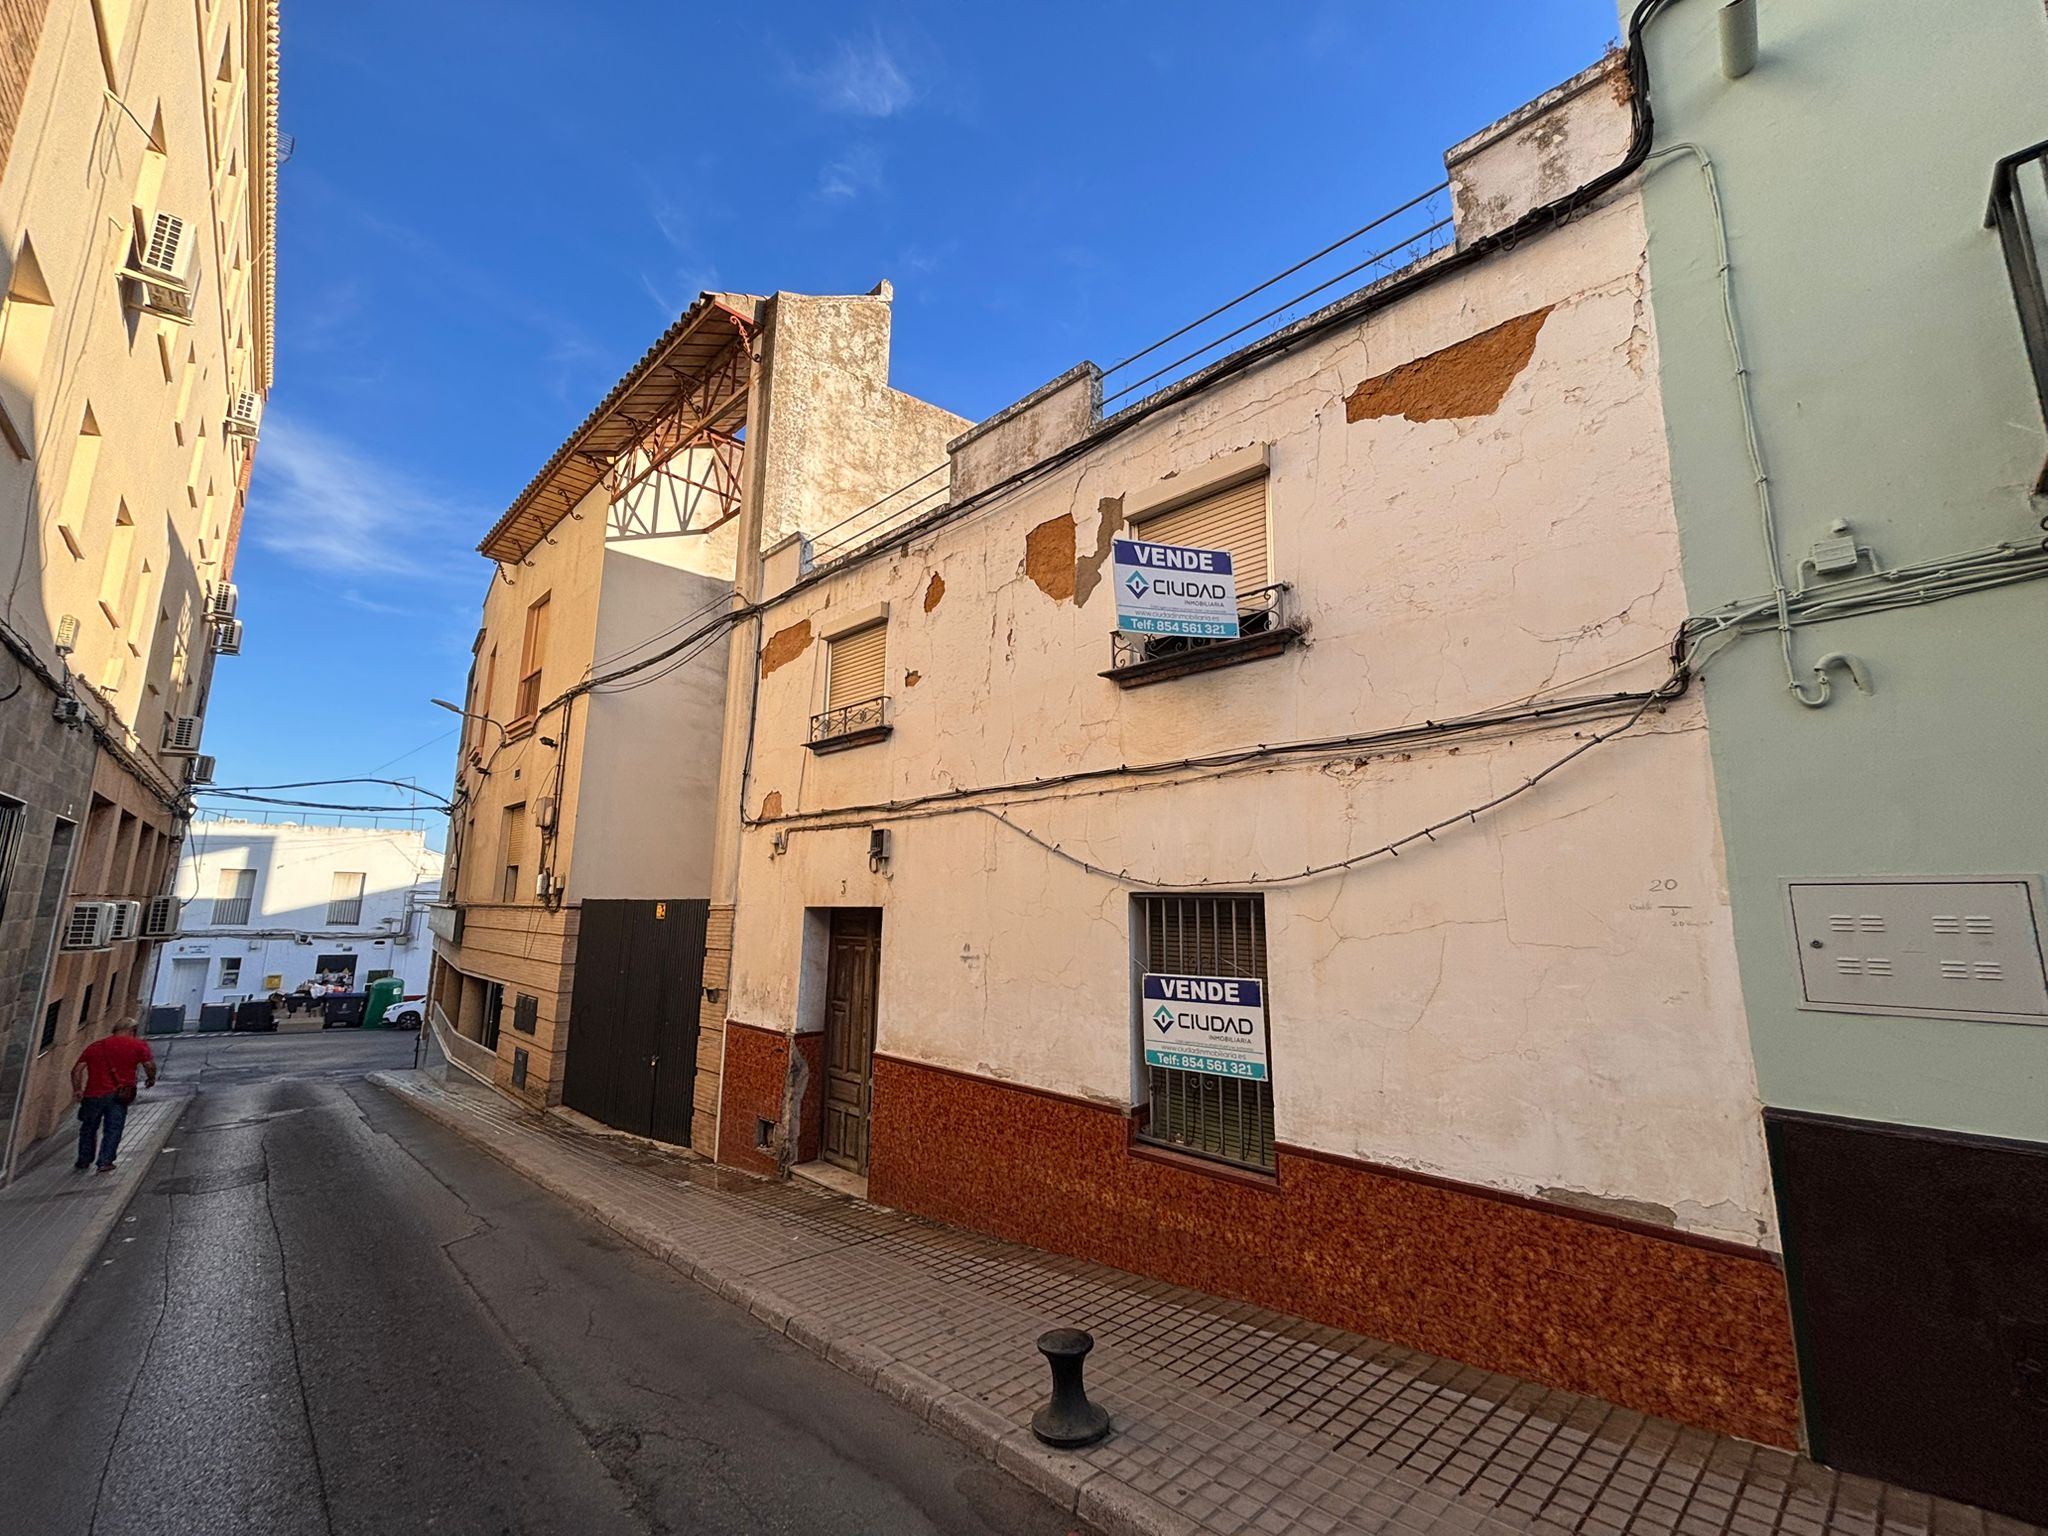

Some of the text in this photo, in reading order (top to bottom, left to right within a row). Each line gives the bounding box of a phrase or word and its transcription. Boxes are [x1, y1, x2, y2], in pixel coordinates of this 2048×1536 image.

[1134, 545, 1214, 571] VENDE
[1153, 579, 1226, 599] CIUDAD
[1135, 610, 1220, 621] www.ciudadinmobiliaria.es
[1130, 618, 1226, 635] Telf: 854 561 321
[1649, 879, 1678, 892] 20
[1160, 979, 1240, 1003] VENDE
[1178, 1013, 1253, 1035] CIUDAD
[1208, 1035, 1252, 1044] INMOBILIARIA
[1161, 1045, 1247, 1060] www.ciudadinmobiliaria.es
[1157, 1053, 1253, 1075] Telf: 854 561 321
